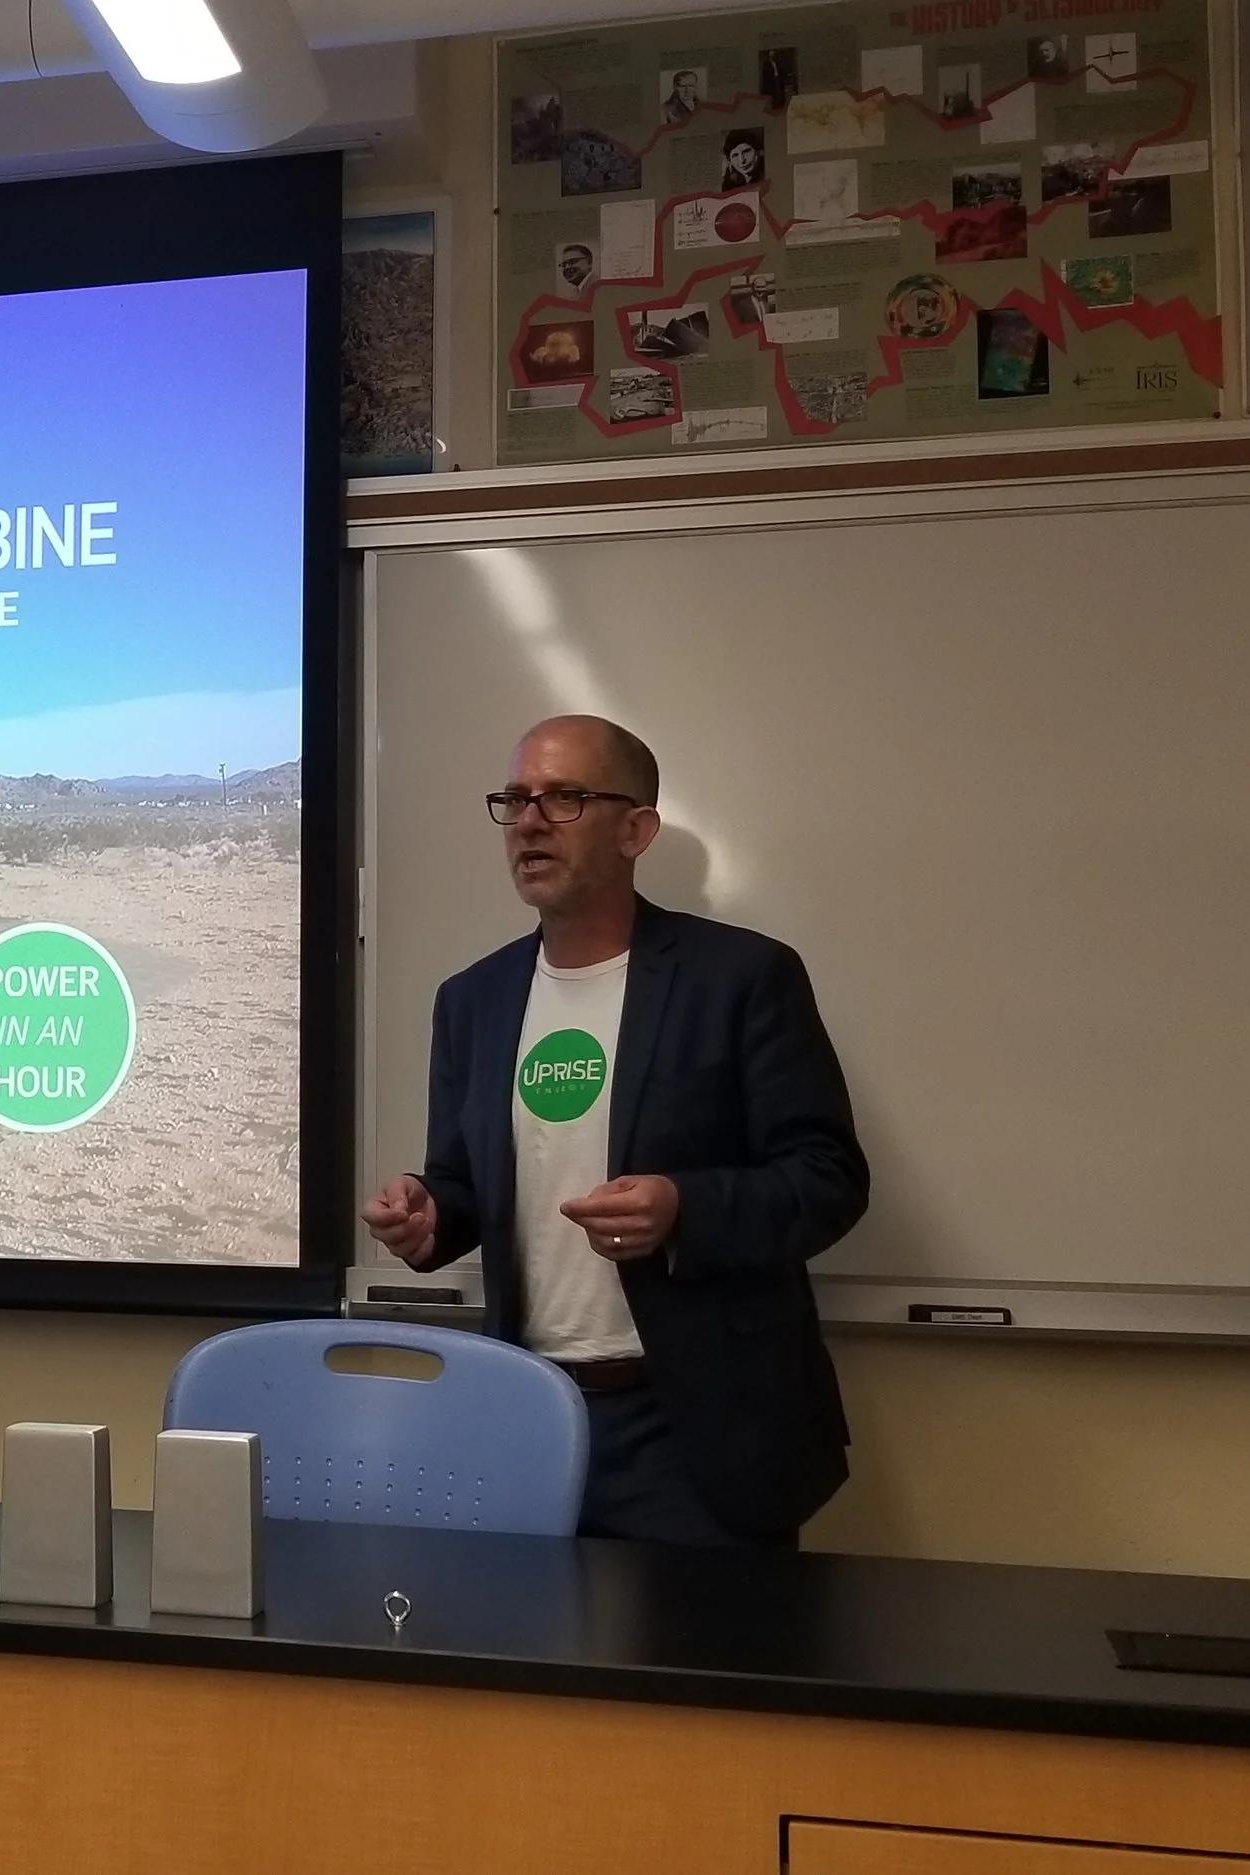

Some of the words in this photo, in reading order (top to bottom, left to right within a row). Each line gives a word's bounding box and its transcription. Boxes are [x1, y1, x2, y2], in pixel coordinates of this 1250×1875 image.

[1136, 370, 1178, 391] IRIS
[34, 1015, 84, 1047] AN
[523, 1059, 603, 1087] UPRISE
